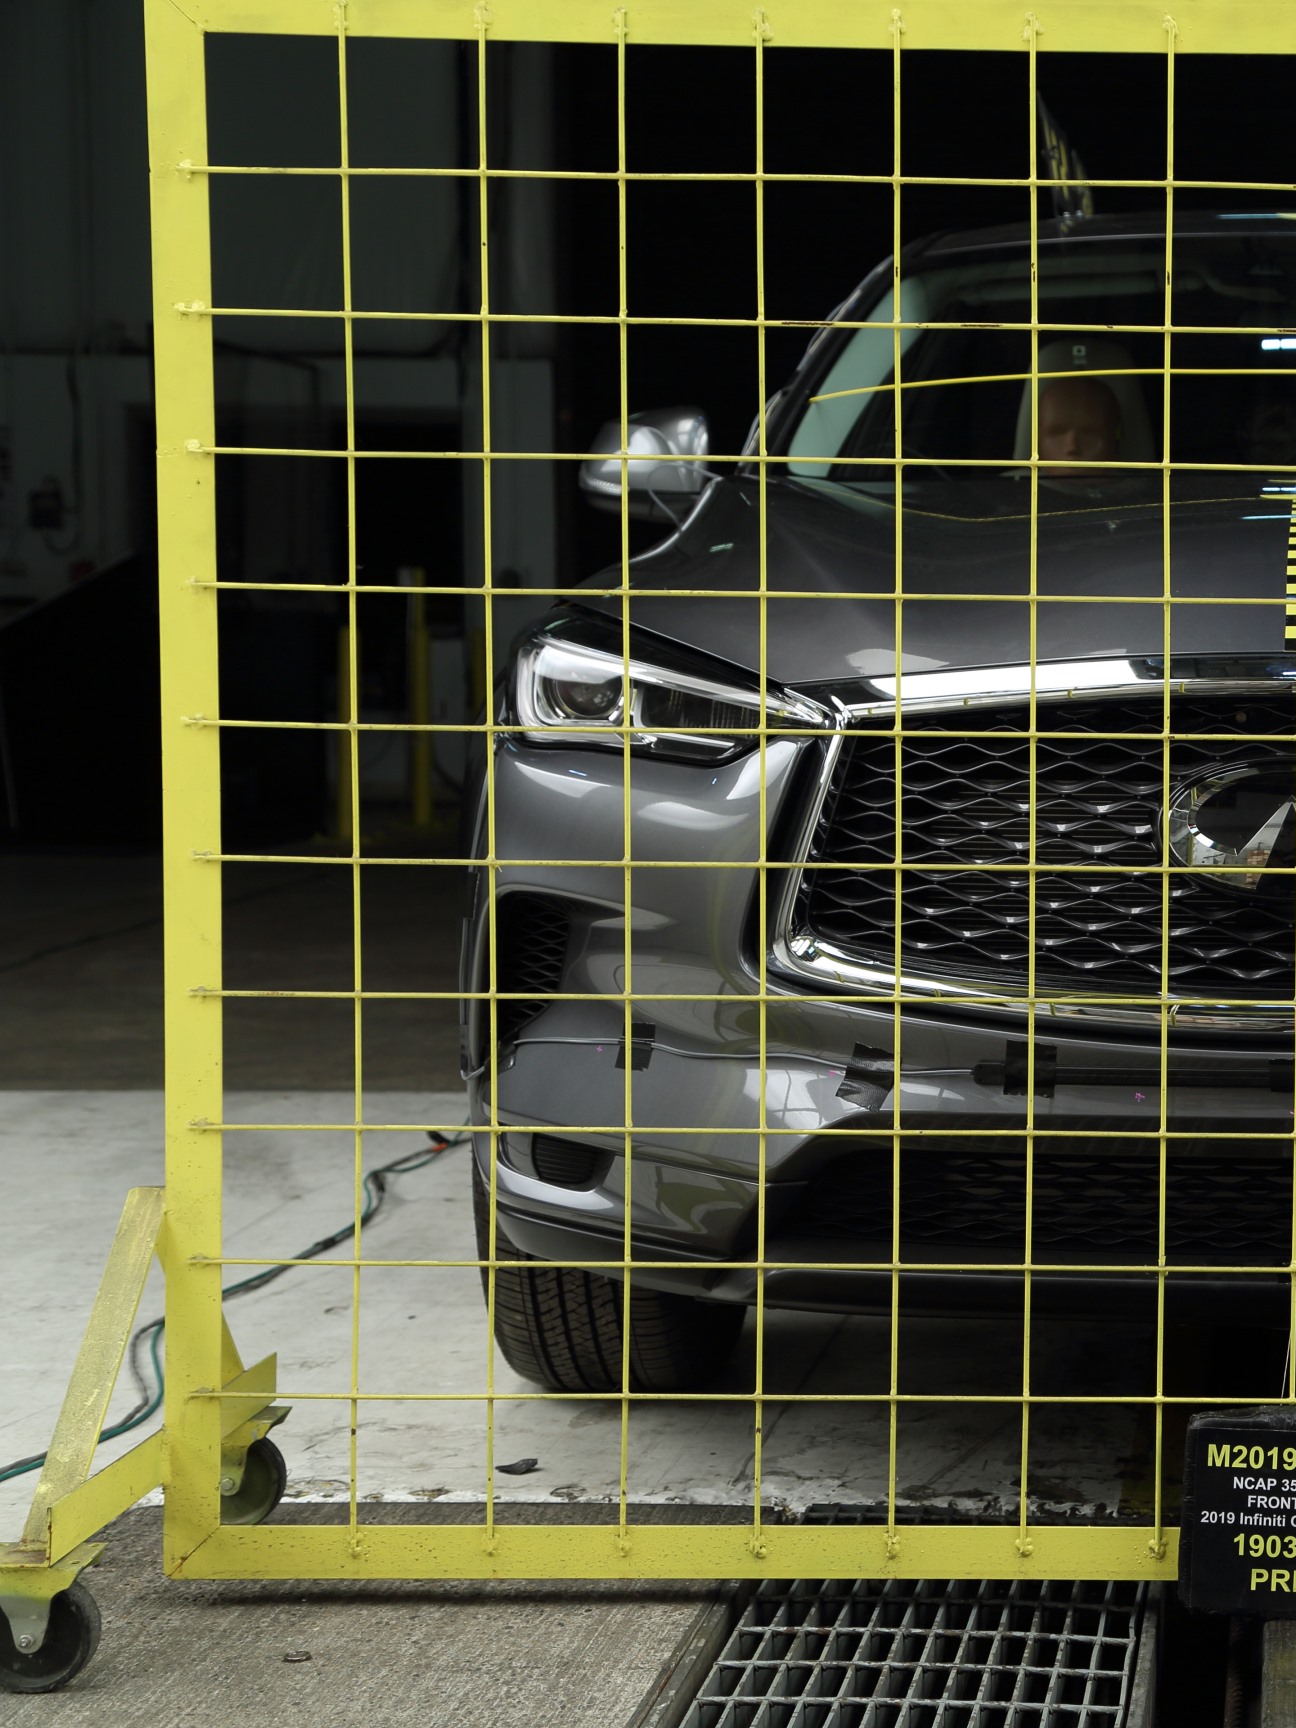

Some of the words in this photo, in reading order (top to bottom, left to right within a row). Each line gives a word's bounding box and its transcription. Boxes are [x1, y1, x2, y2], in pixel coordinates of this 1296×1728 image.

[1234, 1477, 1277, 1490] NCAP
[1201, 1511, 1235, 1524] 2019
[1240, 1513, 1285, 1526] Infiniti
